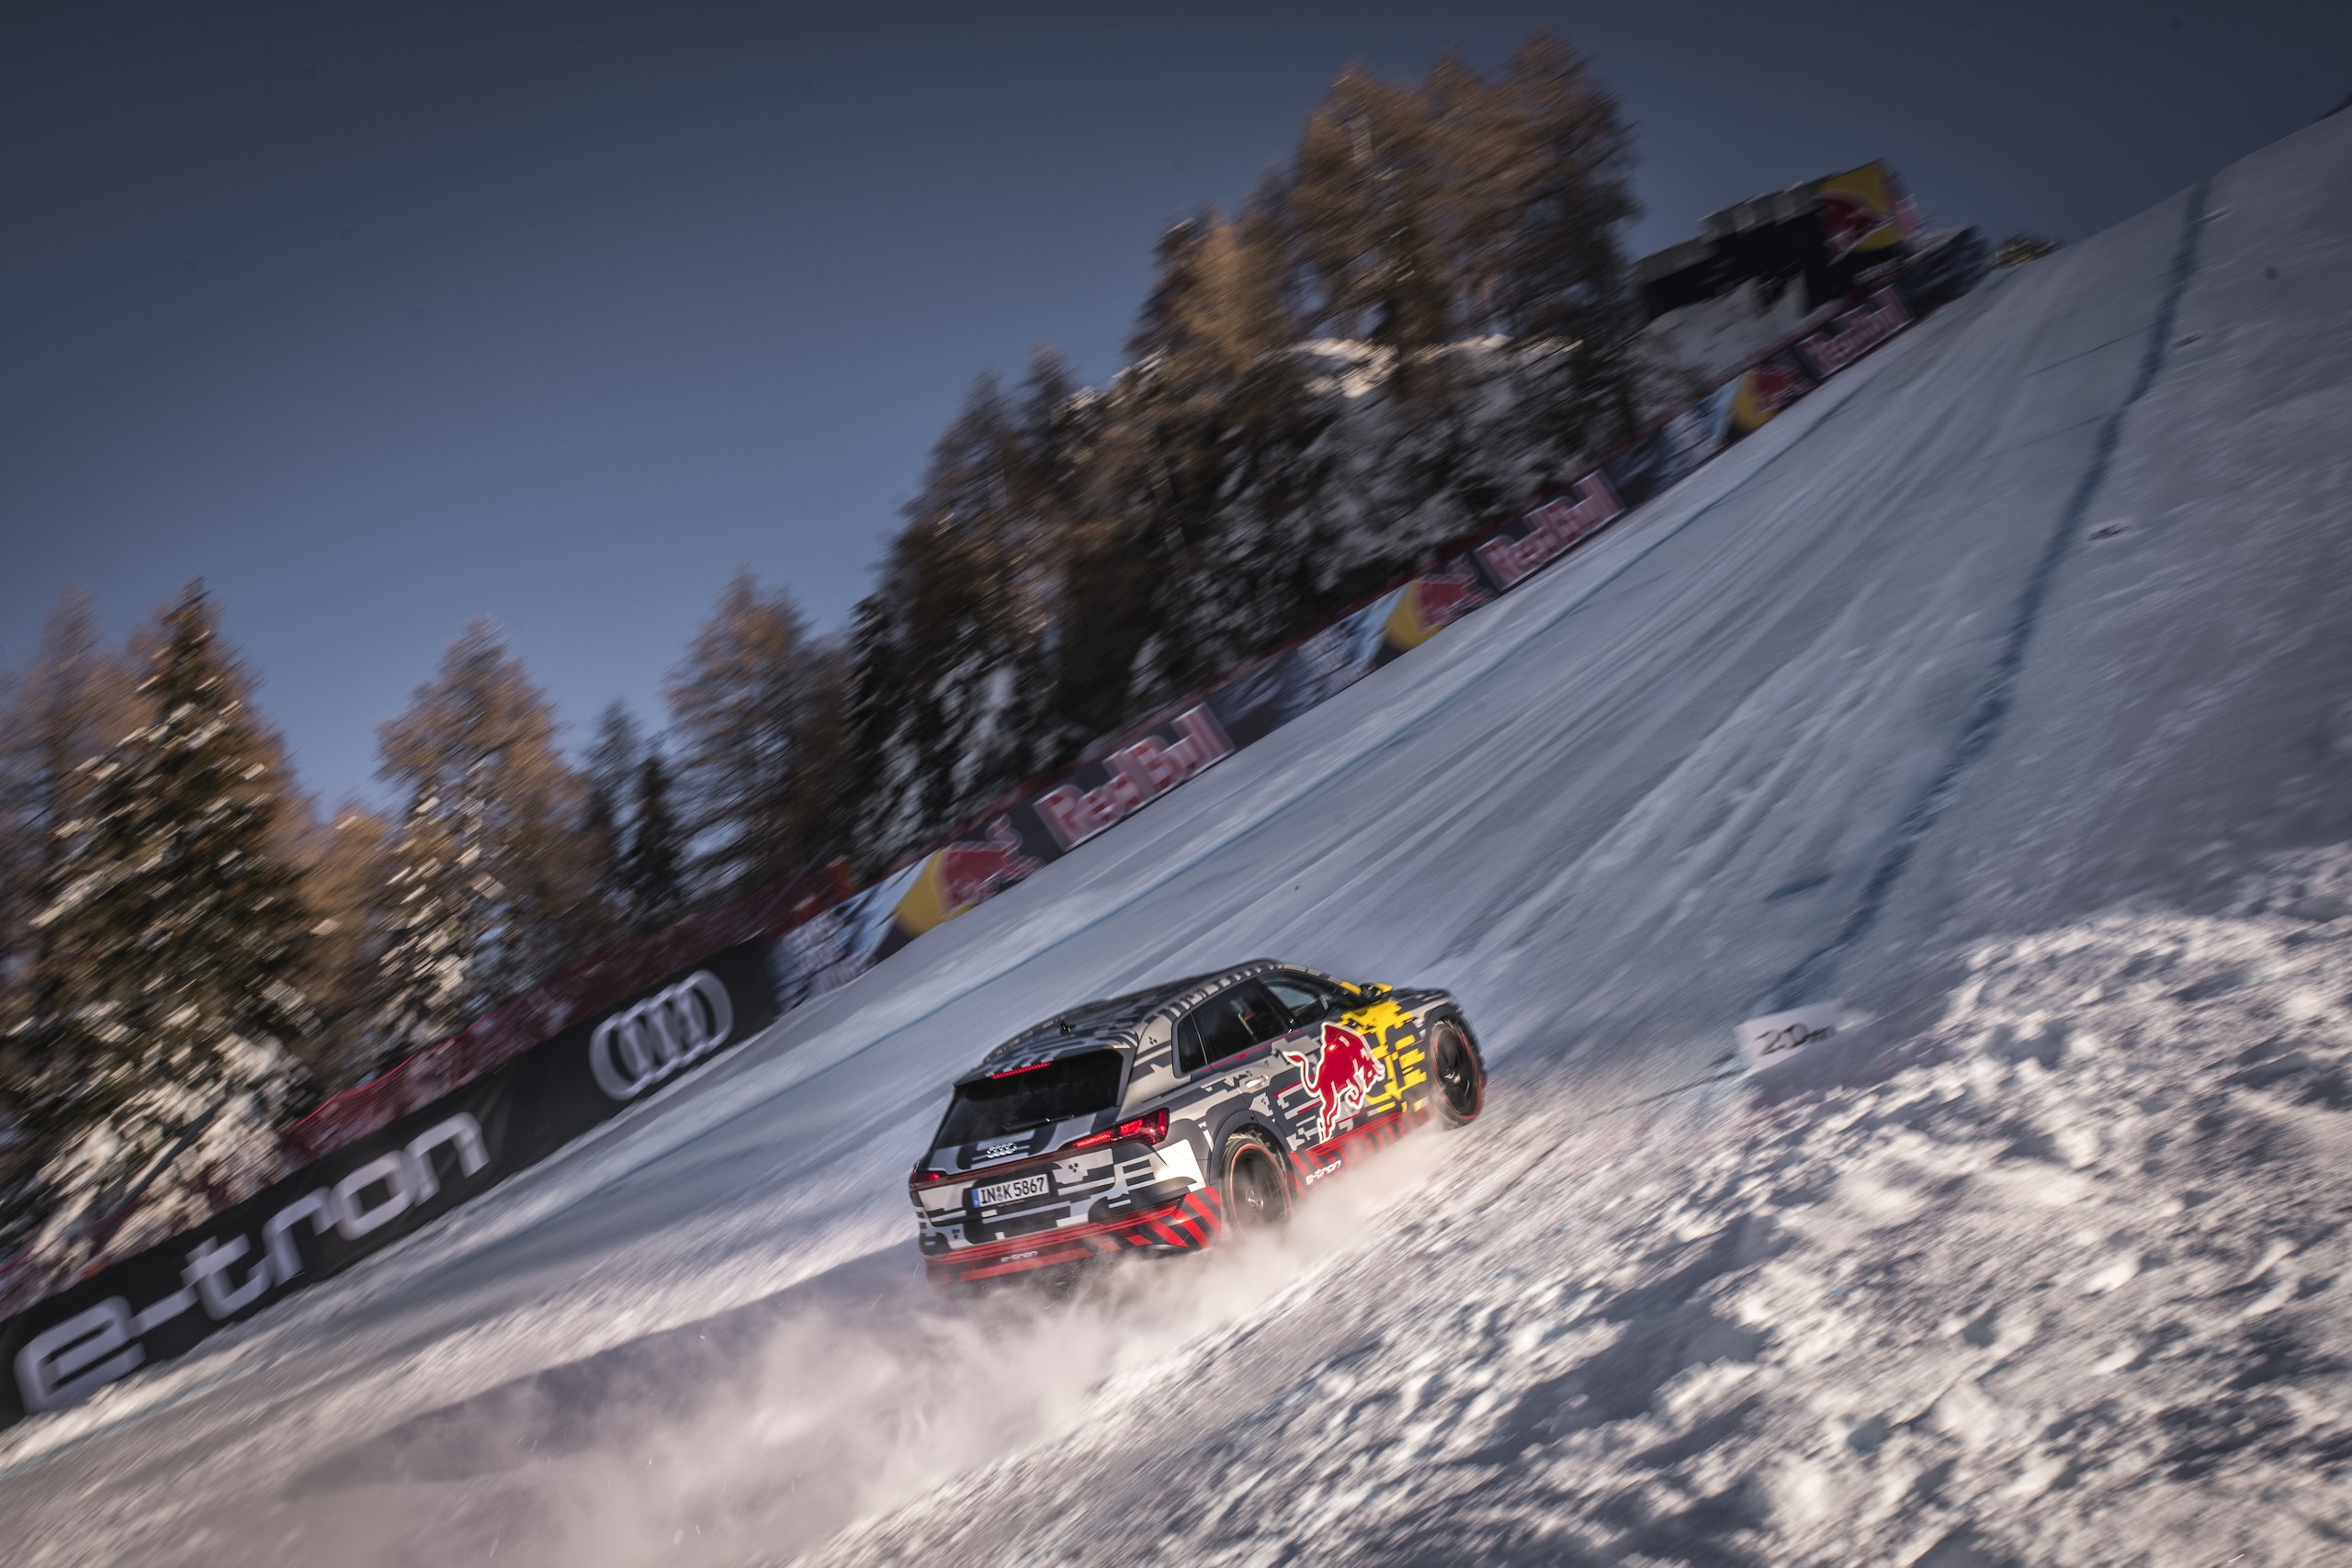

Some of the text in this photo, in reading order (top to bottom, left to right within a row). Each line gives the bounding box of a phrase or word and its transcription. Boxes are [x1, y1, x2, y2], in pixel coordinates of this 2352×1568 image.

[1032, 747, 1150, 852] Red
[1306, 1159, 1341, 1186] e-tron
[1013, 1177, 1045, 1197] 5867
[13, 1111, 492, 1416] e-tron
[1001, 1250, 1038, 1262] e-tron
